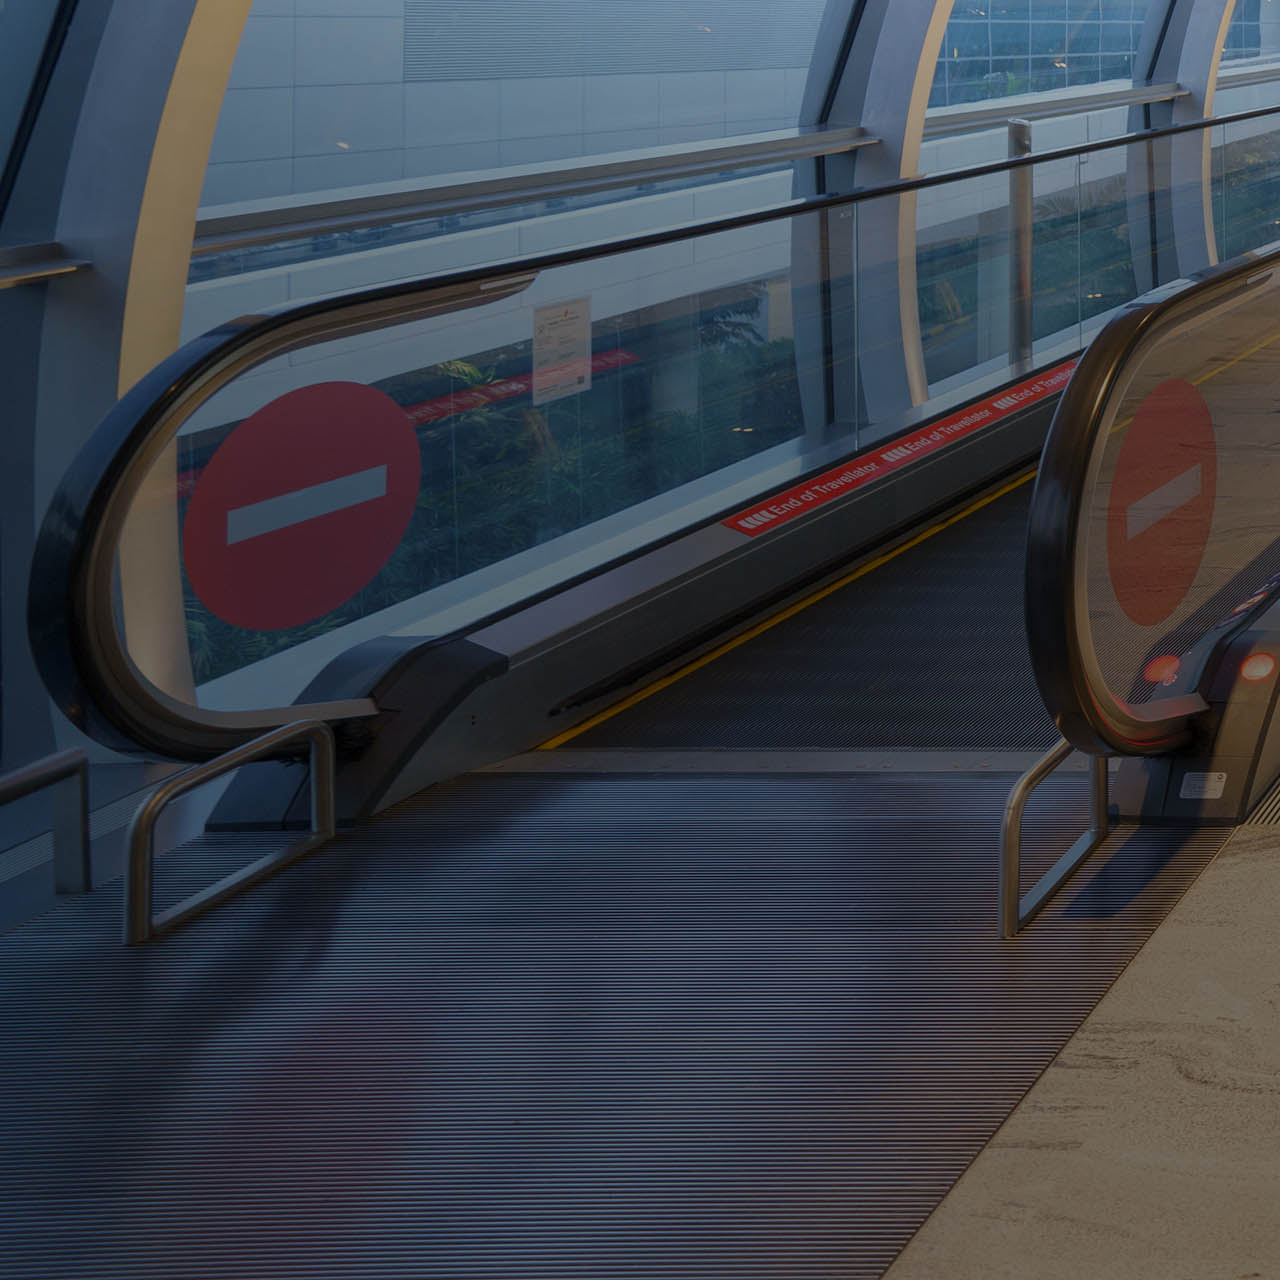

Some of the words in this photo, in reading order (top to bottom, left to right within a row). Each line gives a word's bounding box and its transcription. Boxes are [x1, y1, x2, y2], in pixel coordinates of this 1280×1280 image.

[1011, 388, 1034, 401] End
[906, 436, 932, 452] End
[930, 428, 945, 441] of
[939, 409, 993, 435] Travellator
[770, 498, 802, 516] End
[801, 490, 819, 503] of
[812, 462, 880, 495] Travellator
